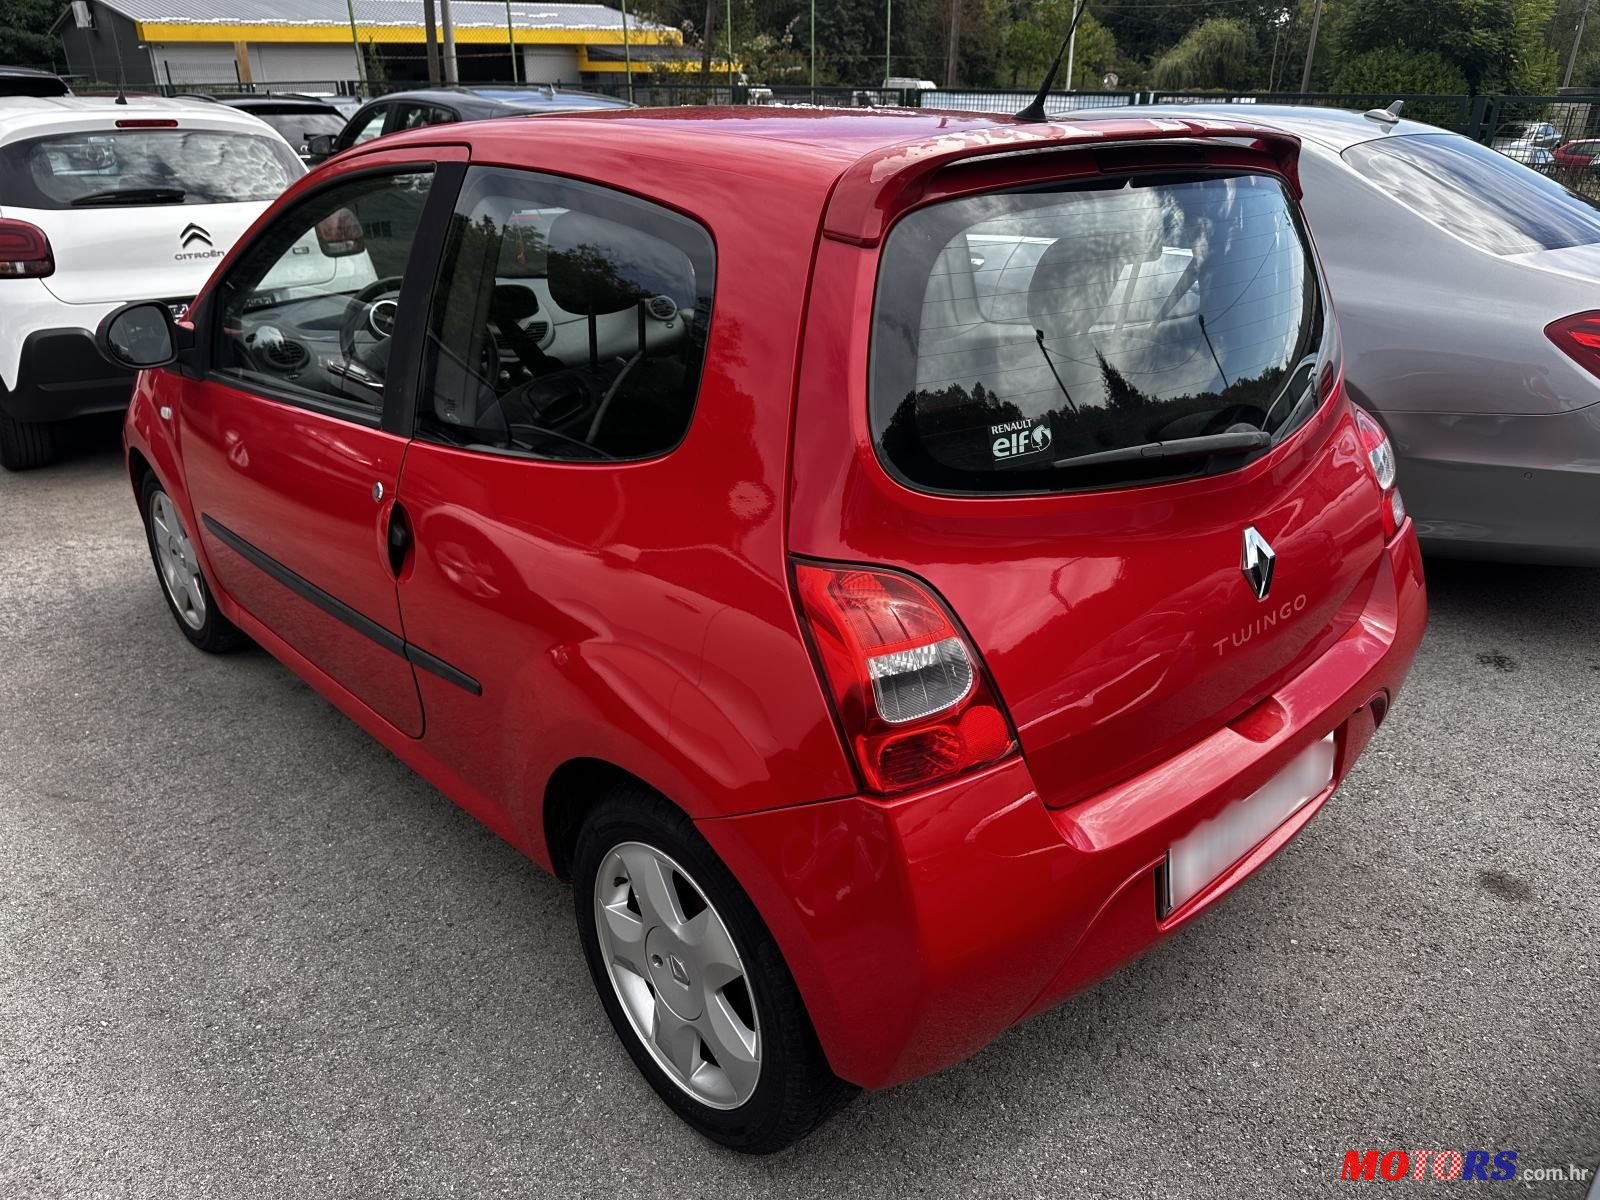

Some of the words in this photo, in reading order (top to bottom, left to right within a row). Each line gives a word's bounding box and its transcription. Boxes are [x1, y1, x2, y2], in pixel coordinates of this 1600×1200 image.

[991, 419, 1032, 435] RENAULT
[992, 430, 1030, 457] elf
[1213, 594, 1307, 656] TWINGO
